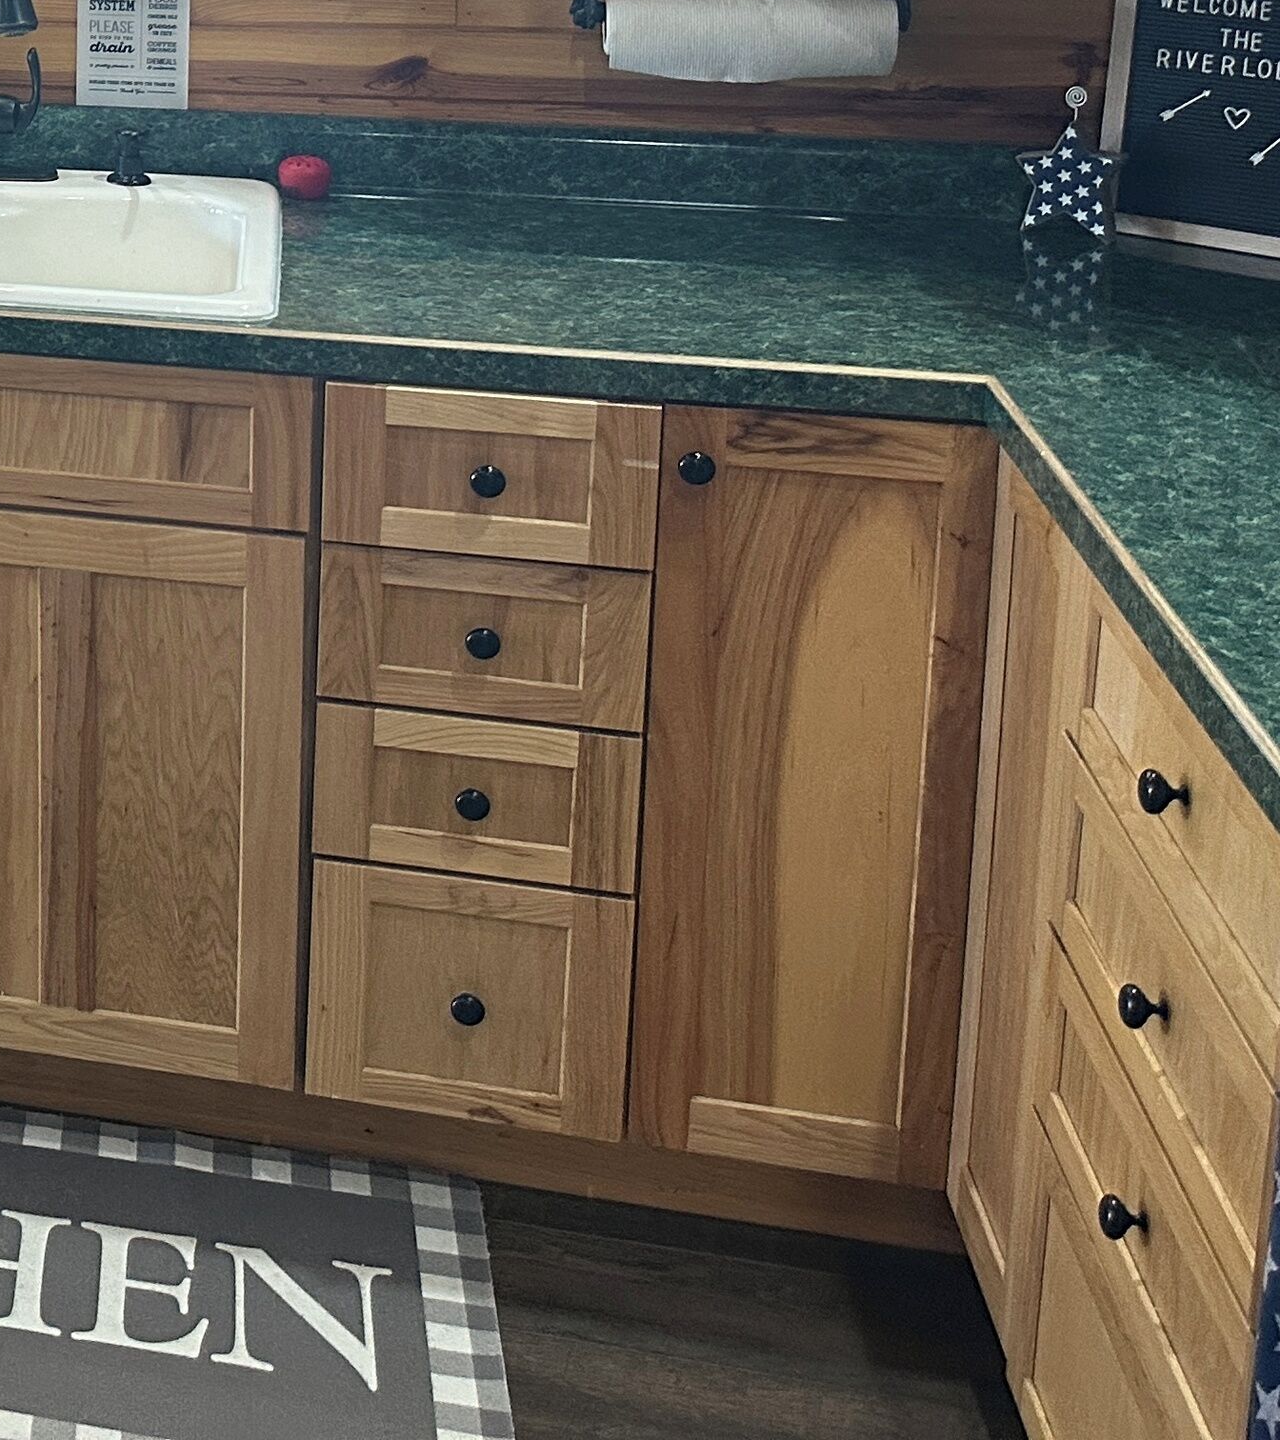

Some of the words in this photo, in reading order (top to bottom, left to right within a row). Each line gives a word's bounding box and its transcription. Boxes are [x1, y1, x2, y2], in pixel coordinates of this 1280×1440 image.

[89, 0, 136, 12] SYSTEM
[89, 20, 135, 34] PLEASE
[1220, 28, 1263, 53] THE
[90, 41, 136, 54] drain
